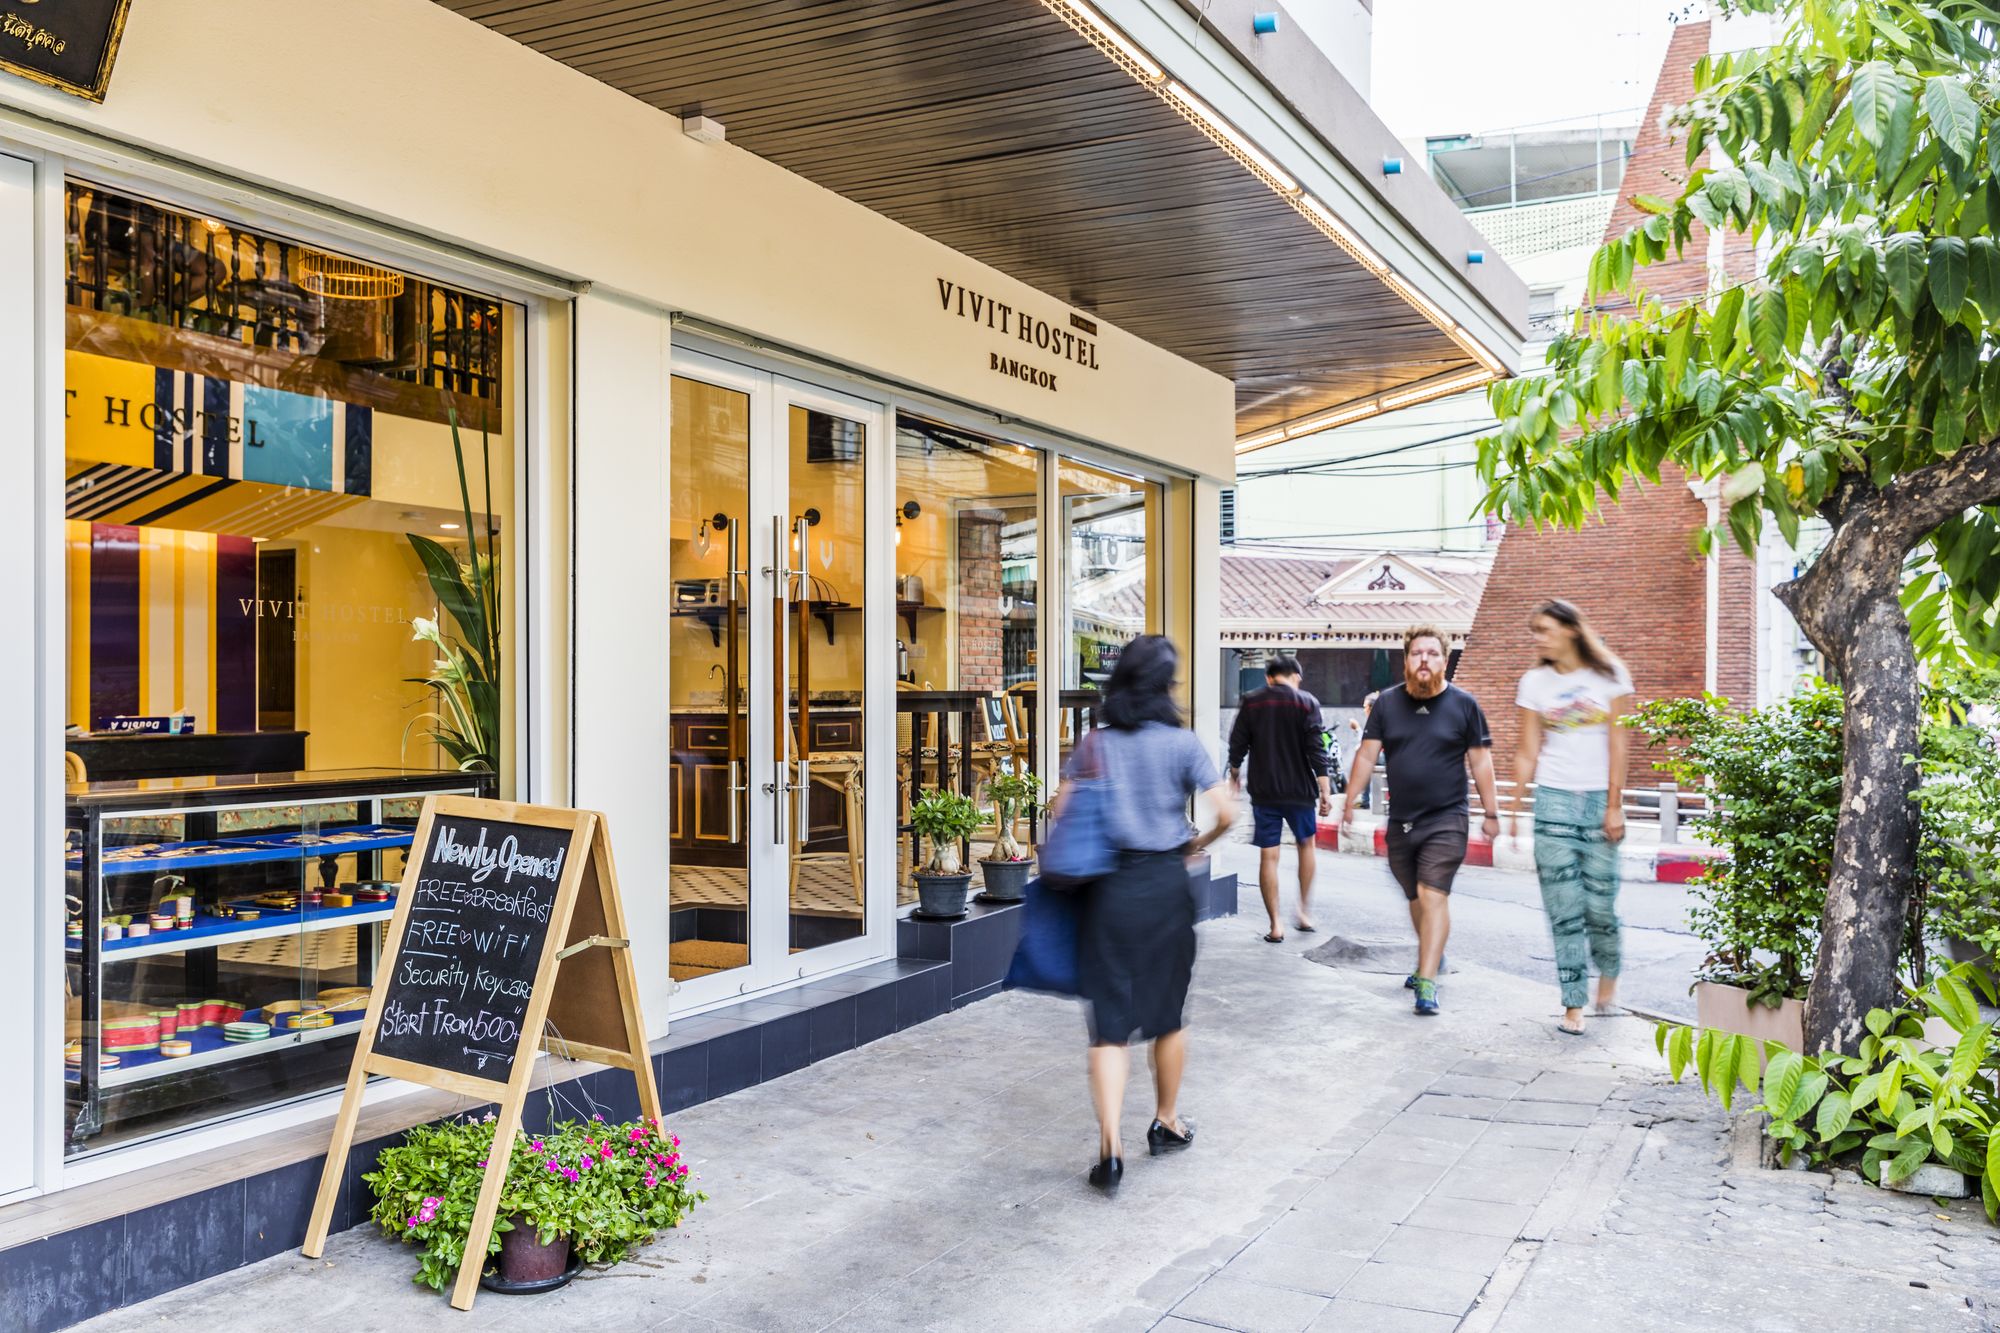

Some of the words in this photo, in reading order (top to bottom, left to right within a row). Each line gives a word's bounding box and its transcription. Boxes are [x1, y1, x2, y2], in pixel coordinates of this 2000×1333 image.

[937, 278, 1012, 334] VIVIT
[1018, 312, 1099, 371] HOSTEL
[990, 352, 1057, 392] BANGKOK
[104, 395, 264, 448] HOSTEL
[239, 599, 309, 620] VIVIT
[322, 604, 407, 625] HOSTEL
[121, 720, 160, 729] Double
[432, 825, 497, 882] Newly
[499, 835, 565, 883] Opened
[417, 879, 466, 903] FREE
[406, 919, 460, 947] FREE
